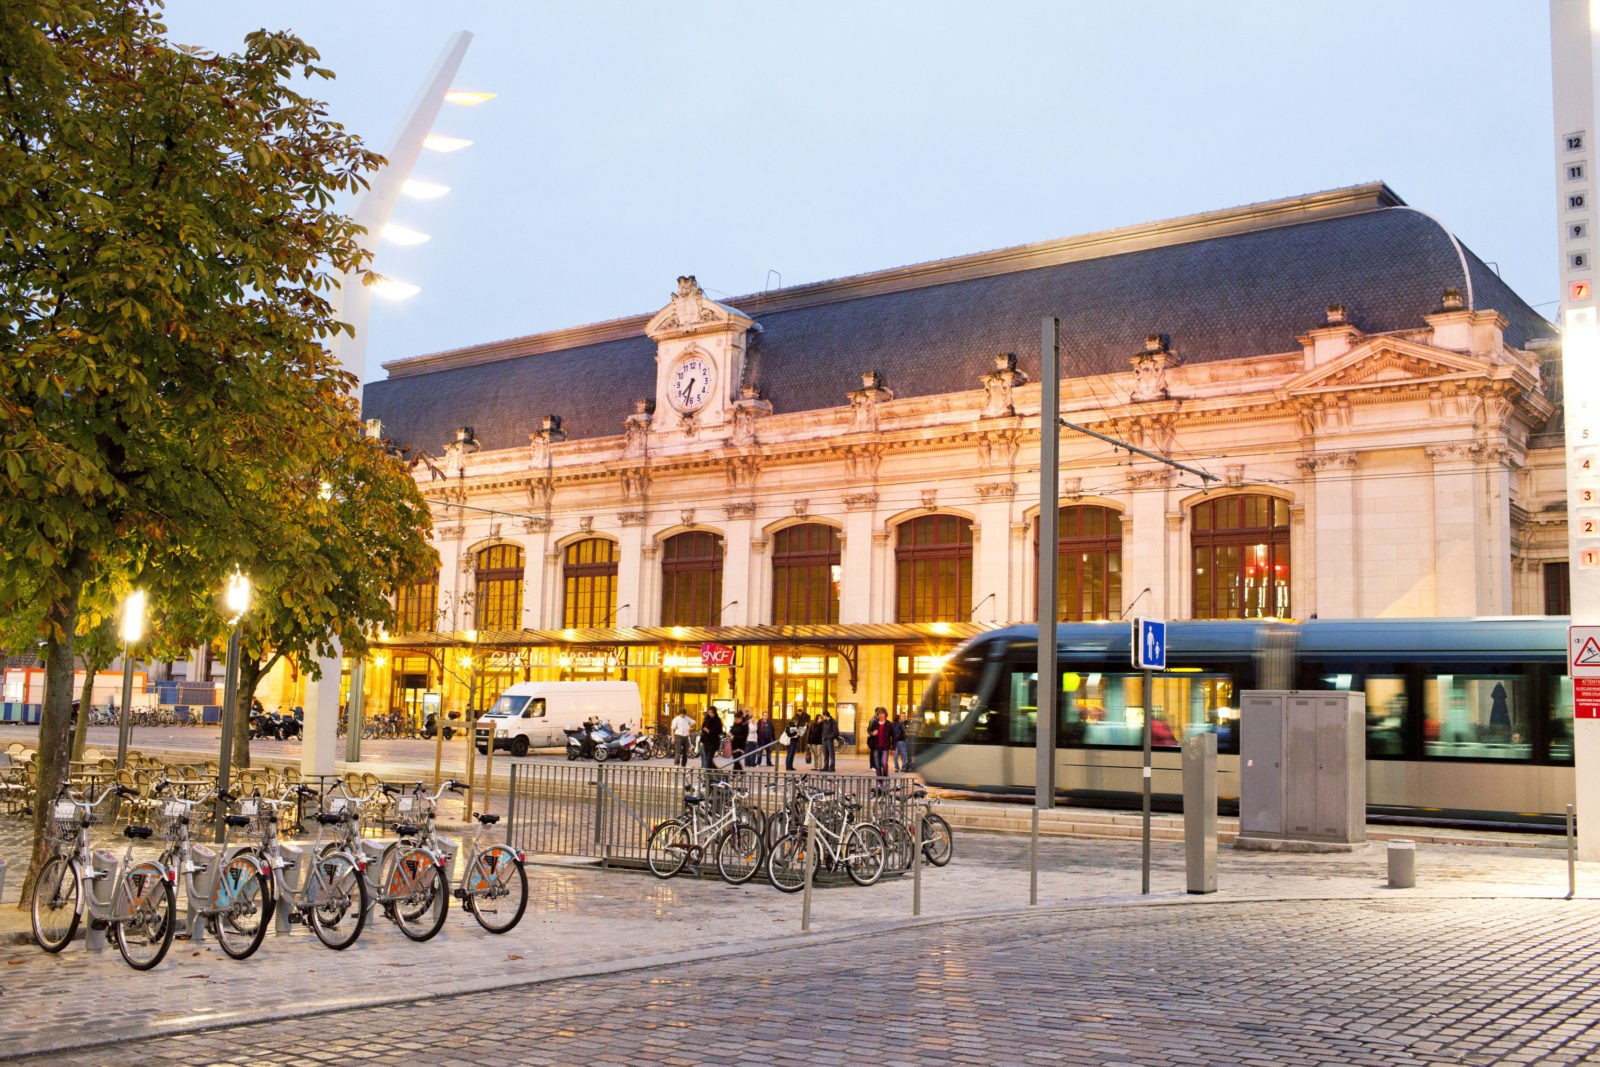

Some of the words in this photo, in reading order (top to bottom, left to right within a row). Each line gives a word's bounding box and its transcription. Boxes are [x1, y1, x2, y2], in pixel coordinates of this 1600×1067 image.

[1568, 138, 1581, 148] 12
[1570, 167, 1581, 178] 11
[1570, 196, 1583, 207] 10
[1574, 226, 1581, 236] 9
[1576, 256, 1582, 266] 8
[1577, 286, 1584, 295] 7
[1582, 429, 1589, 440] 5
[1582, 460, 1590, 470] 4
[1584, 492, 1591, 501] 3
[1586, 523, 1592, 532] 2
[1588, 553, 1592, 563] 1
[491, 651, 523, 666] GARE
[529, 650, 546, 666] DE
[628, 650, 644, 666] ST
[702, 650, 731, 662] SNCF
